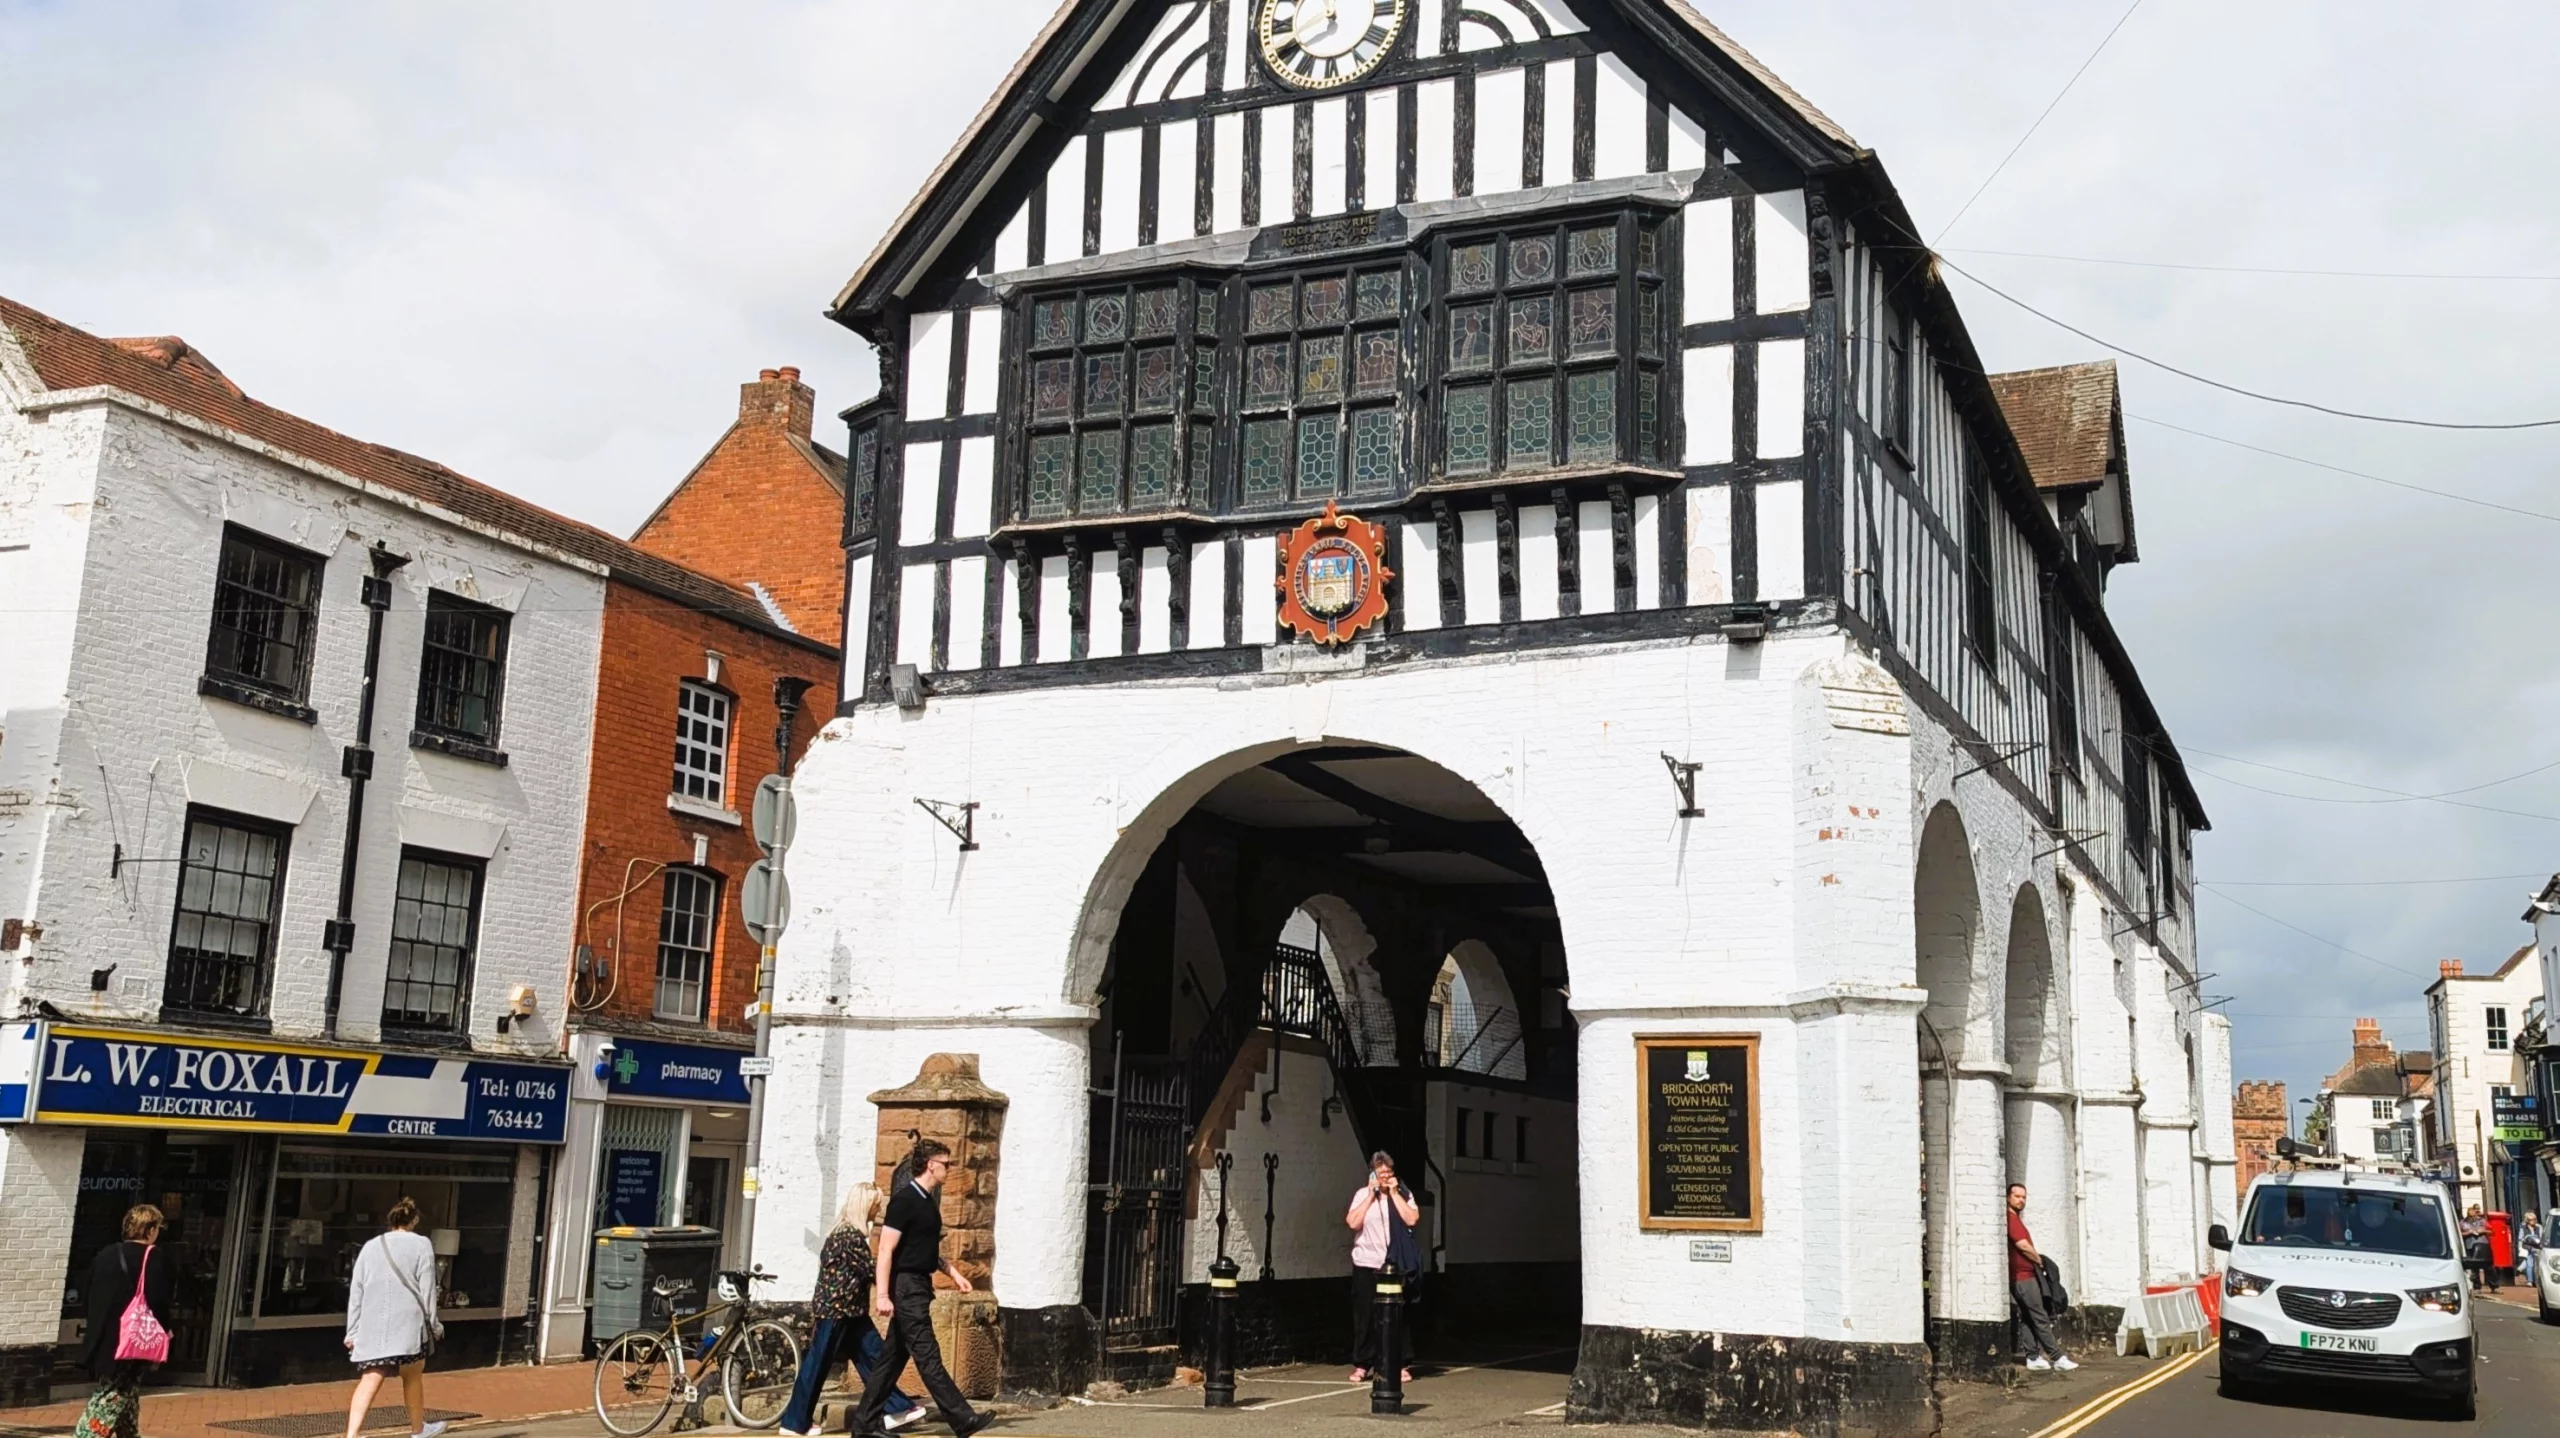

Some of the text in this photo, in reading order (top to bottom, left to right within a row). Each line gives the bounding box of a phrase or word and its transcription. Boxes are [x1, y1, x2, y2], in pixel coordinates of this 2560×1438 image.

[46, 1038, 351, 1098] L. W. FOXALL
[660, 1061, 722, 1085] pharmacy
[480, 1077, 556, 1100] Tel: 01746
[1662, 1083, 1733, 1095] BRIDGNORTH
[138, 1094, 257, 1119] ELECTRICAL
[1666, 1096, 1730, 1107] TOWN HALL
[486, 1108, 544, 1130] 763442
[1670, 1115, 1726, 1125] Historic Building
[387, 1119, 437, 1135] CENTRE
[1674, 1125, 1685, 1133] Old
[1707, 1126, 1729, 1134] House
[2504, 1129, 2543, 1138] TO LET
[1658, 1144, 1739, 1153] OPEN TO THE PUBLIC
[1677, 1155, 1720, 1163] TEA ROOM
[1666, 1165, 1732, 1174] SOUVENIR SALES
[80, 1175, 145, 1190] euronics
[1671, 1184, 1728, 1193] LICENSED FOR
[1678, 1194, 1722, 1203] WEDDINGS
[2282, 1254, 2404, 1269] openreach
[2309, 1334, 2376, 1352] FP72 KNU
